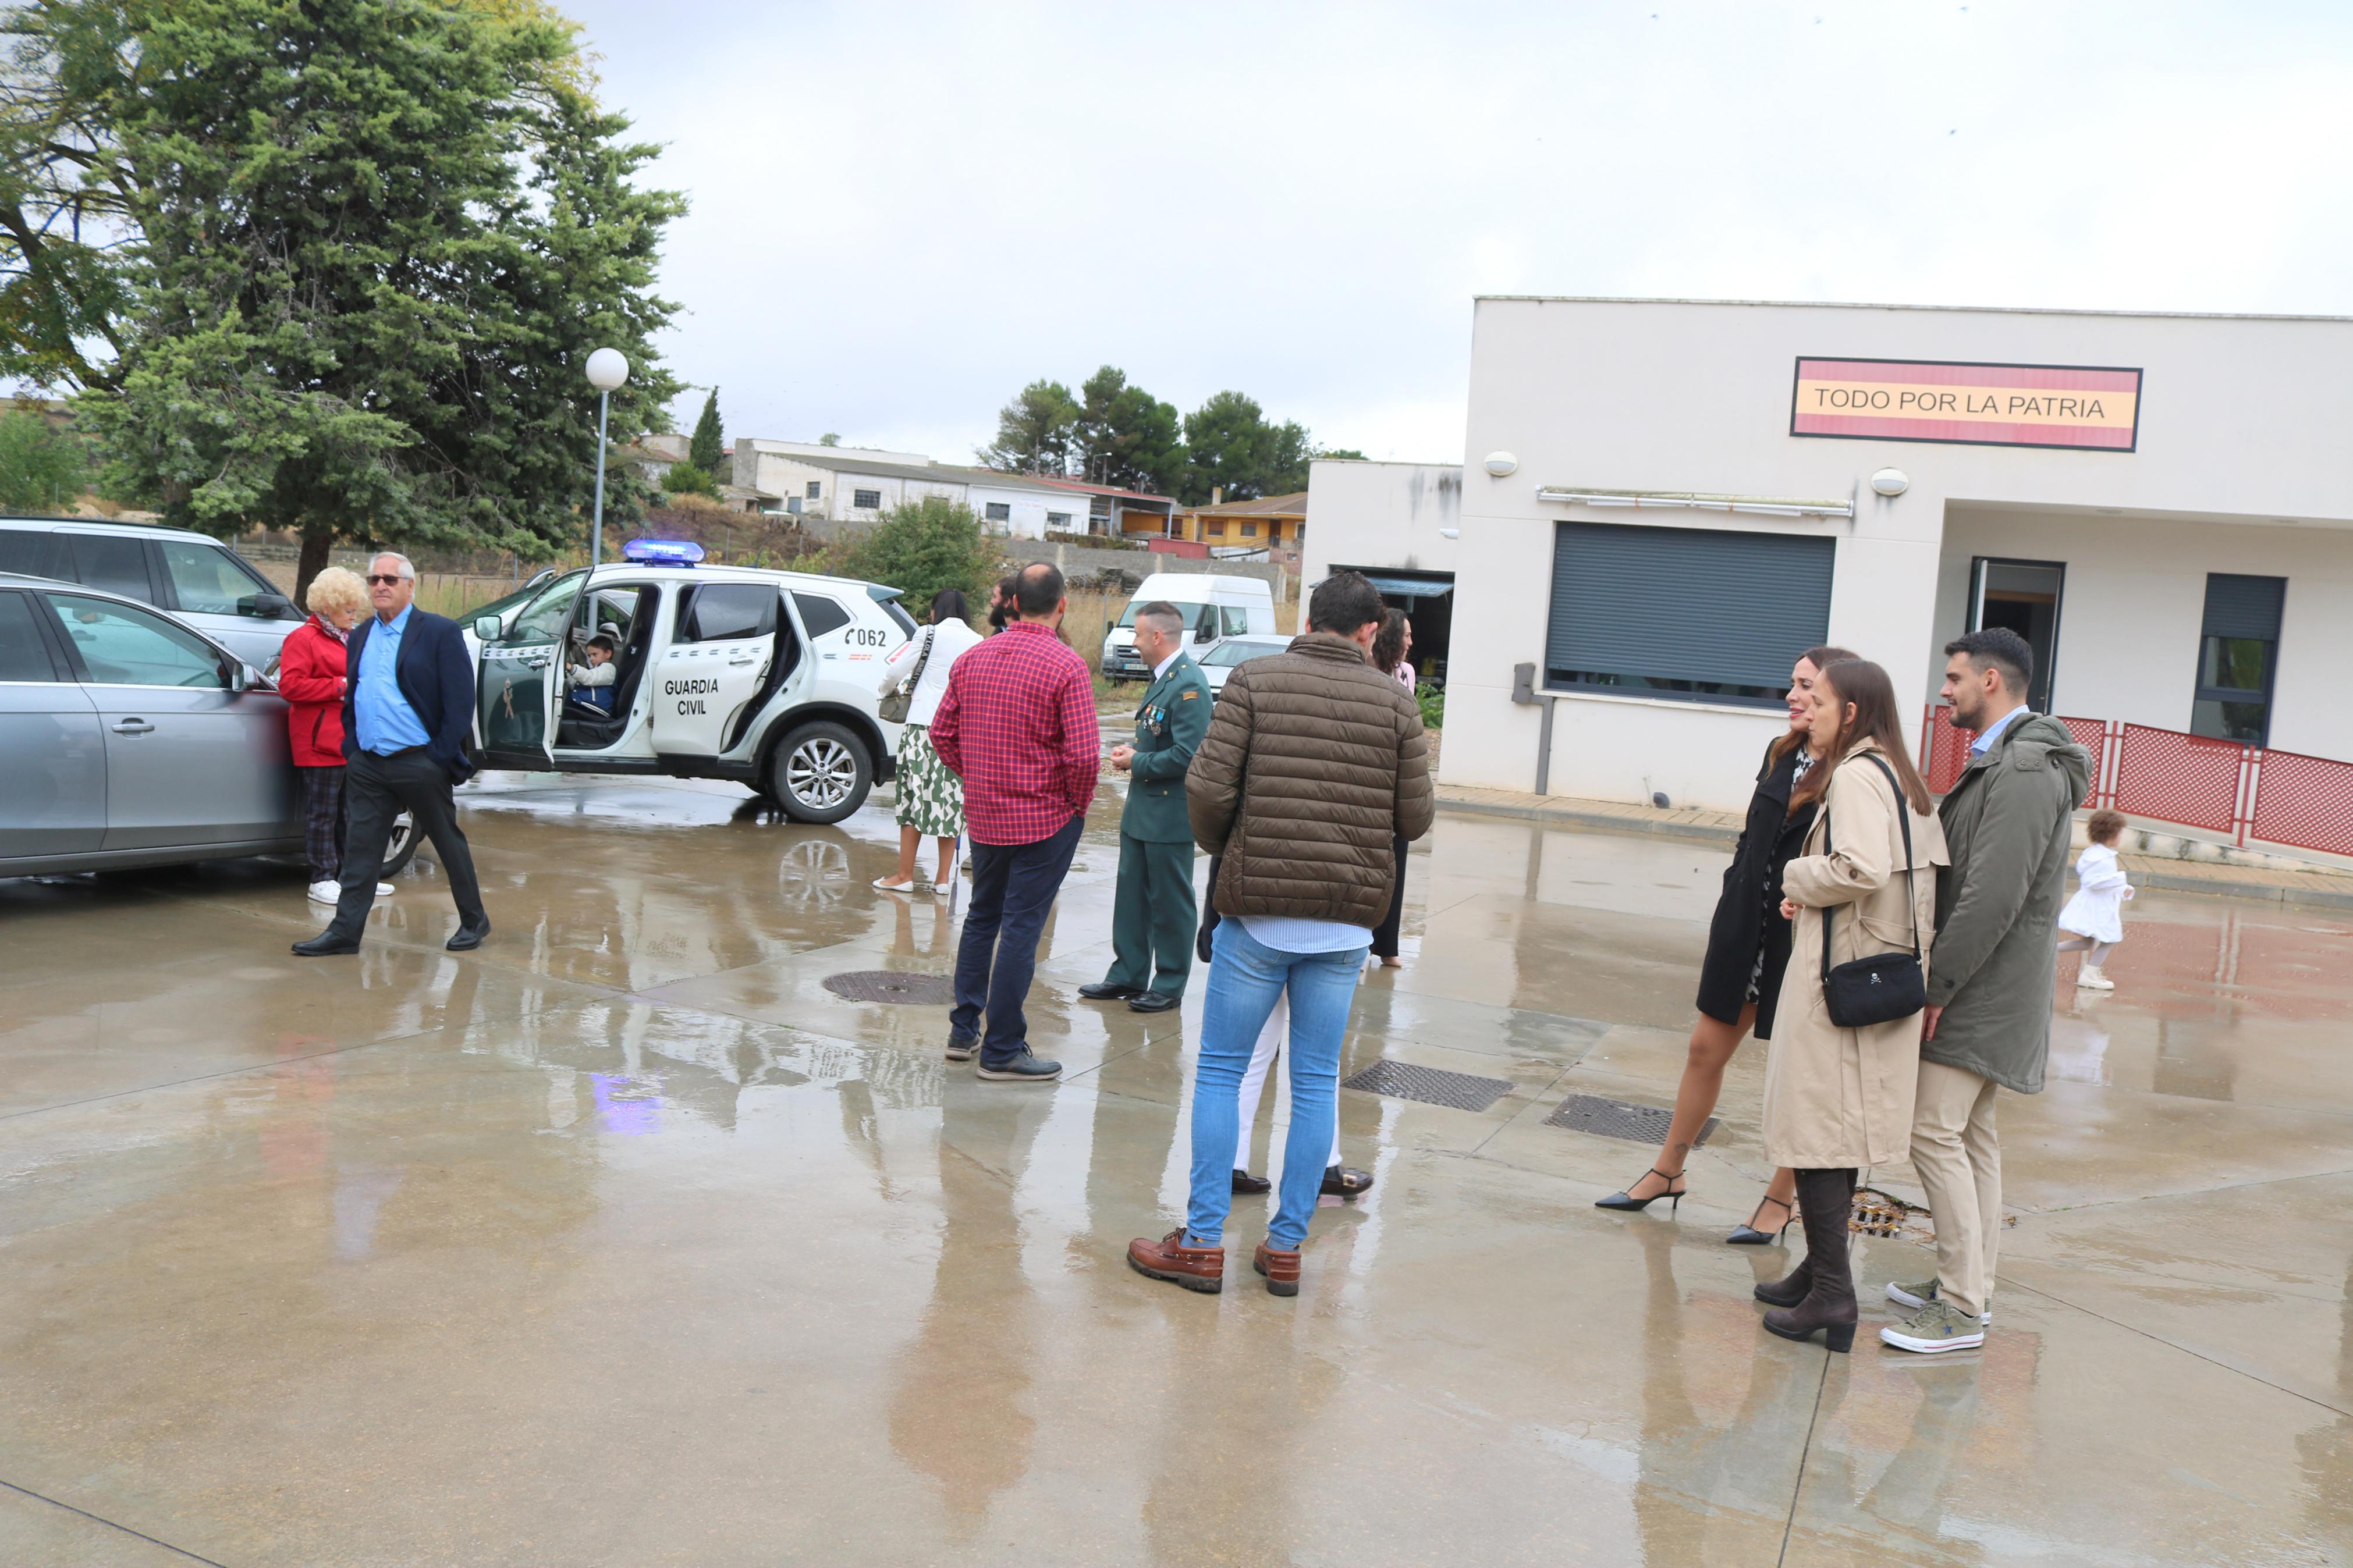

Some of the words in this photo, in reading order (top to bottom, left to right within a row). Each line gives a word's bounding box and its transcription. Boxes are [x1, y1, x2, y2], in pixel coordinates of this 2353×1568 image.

[1814, 388, 1890, 410] TODO
[1900, 391, 1957, 412] POR
[1967, 394, 1999, 414] LA
[2008, 396, 2105, 419] PATRIA
[858, 628, 886, 648] 062
[665, 678, 719, 695] GUARDIA
[677, 699, 707, 716] CIVIL
